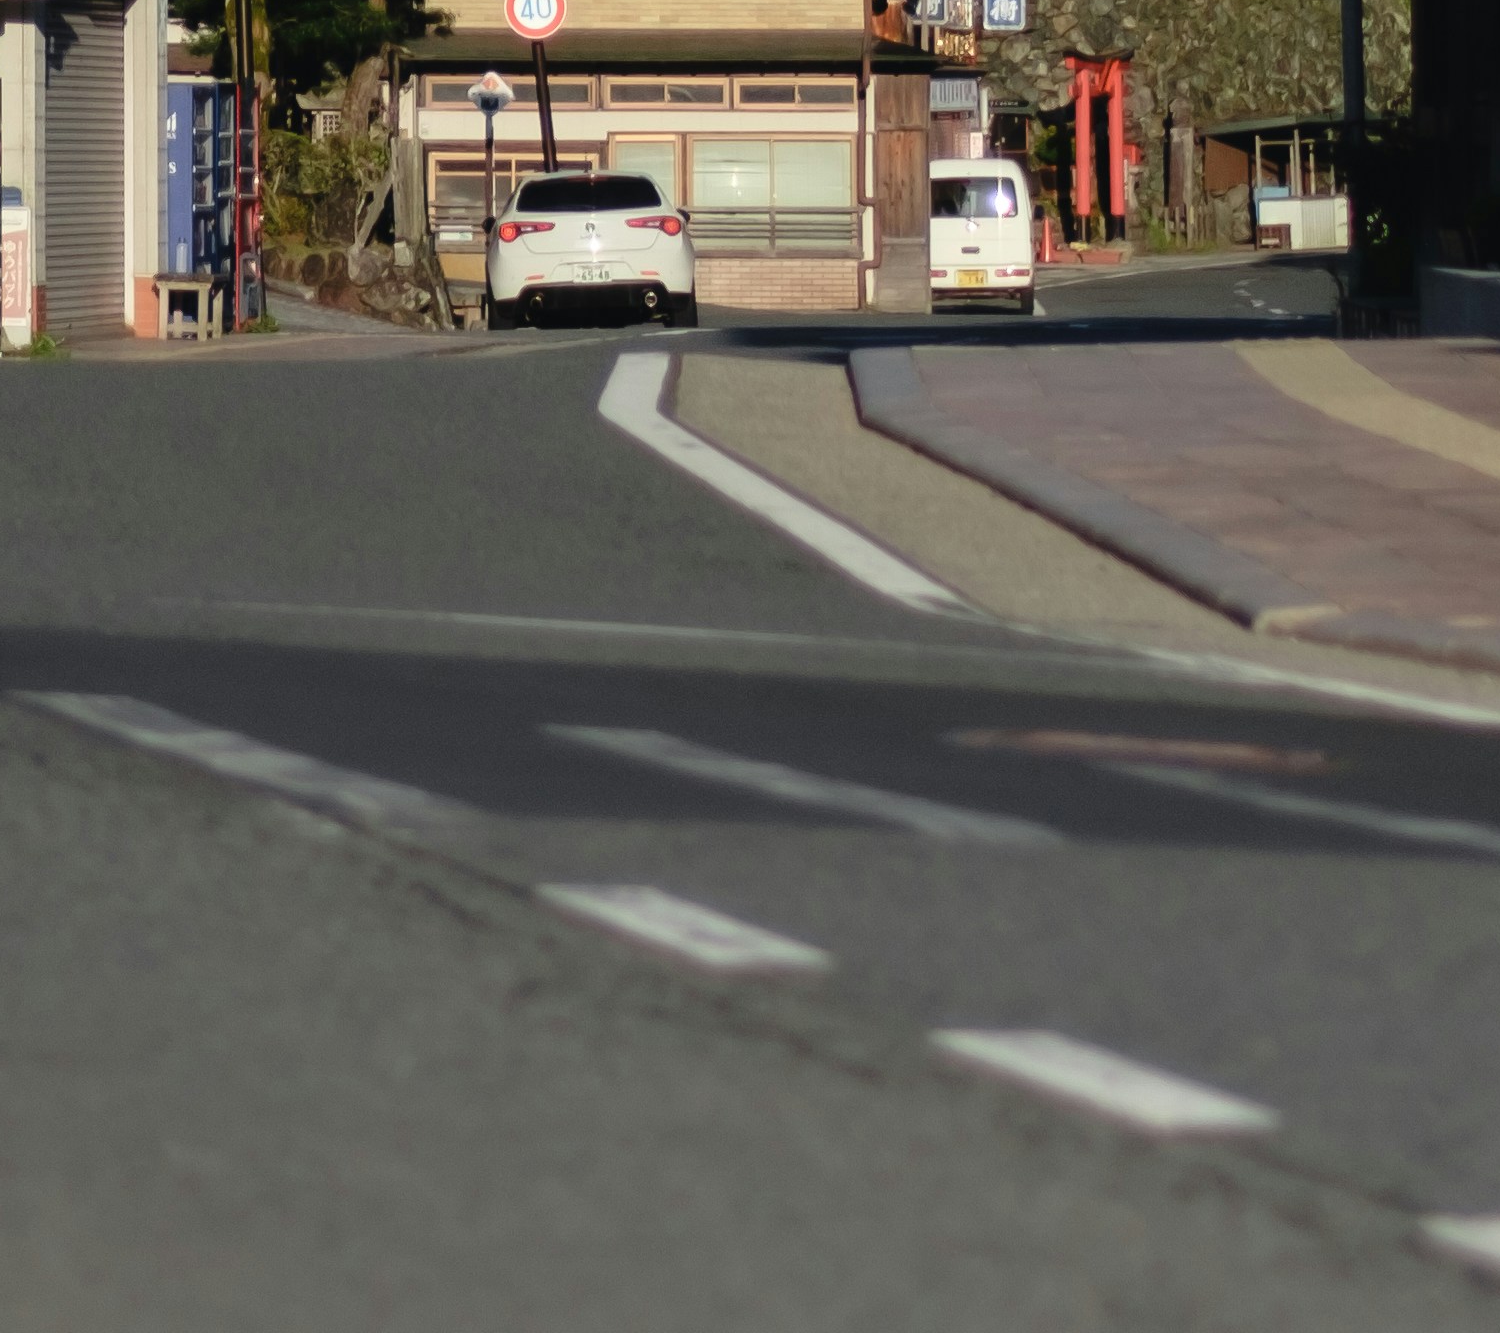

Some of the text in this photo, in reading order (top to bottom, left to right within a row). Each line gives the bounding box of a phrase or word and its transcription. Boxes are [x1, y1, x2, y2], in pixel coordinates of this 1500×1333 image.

[3, 239, 17, 310] ゆうパック
